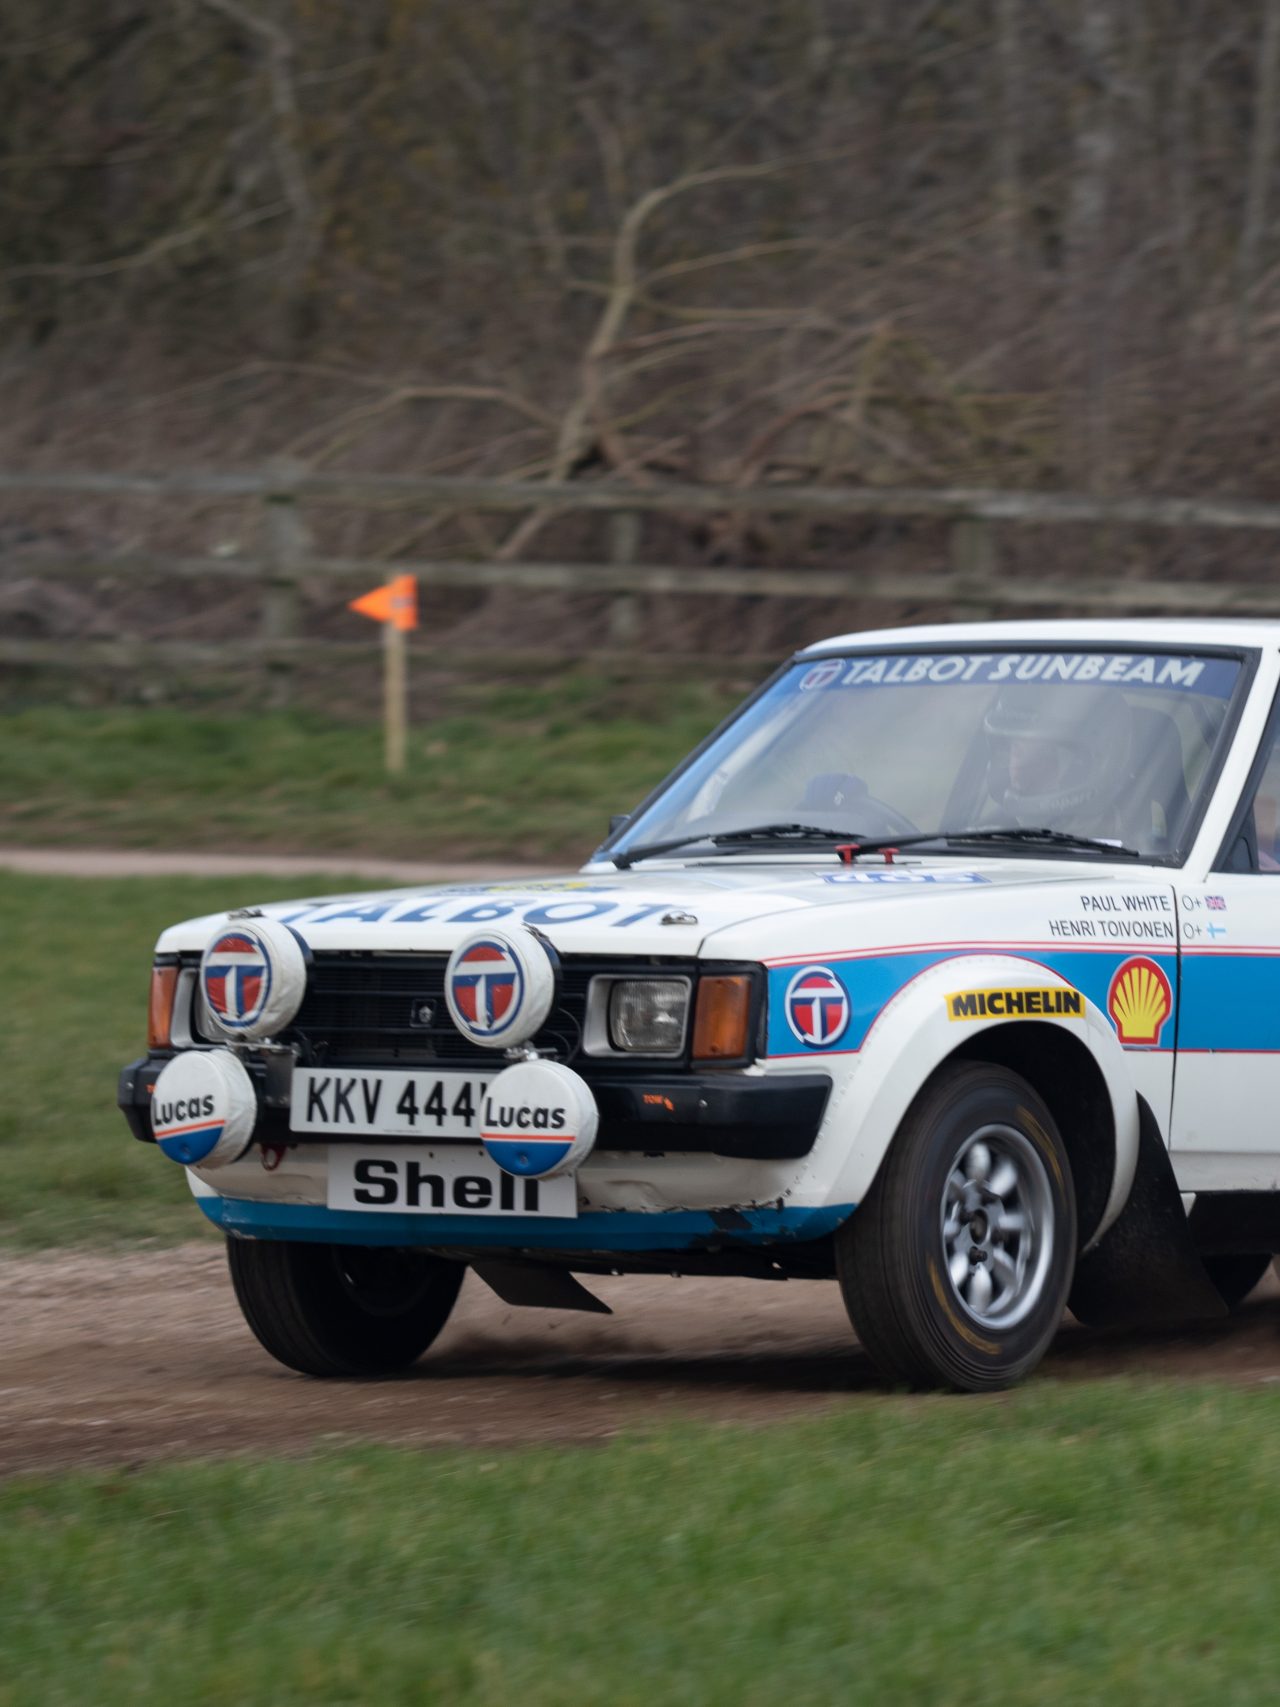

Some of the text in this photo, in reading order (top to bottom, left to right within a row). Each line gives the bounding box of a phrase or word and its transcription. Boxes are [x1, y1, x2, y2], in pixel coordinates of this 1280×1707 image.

[842, 655, 1206, 687] TALBOT SUNBEAM
[278, 897, 690, 927] TALBOT
[1081, 895, 1121, 911] PAUL
[1122, 895, 1171, 912] WHITE
[1049, 920, 1097, 937] HENRI
[1099, 920, 1174, 938] TOIVONEN
[952, 991, 1081, 1016] MICHELIN
[154, 1094, 214, 1126] Lucas
[306, 1076, 487, 1127] KKV 444
[485, 1097, 565, 1129] Lucas
[354, 1159, 539, 1211] Shell
